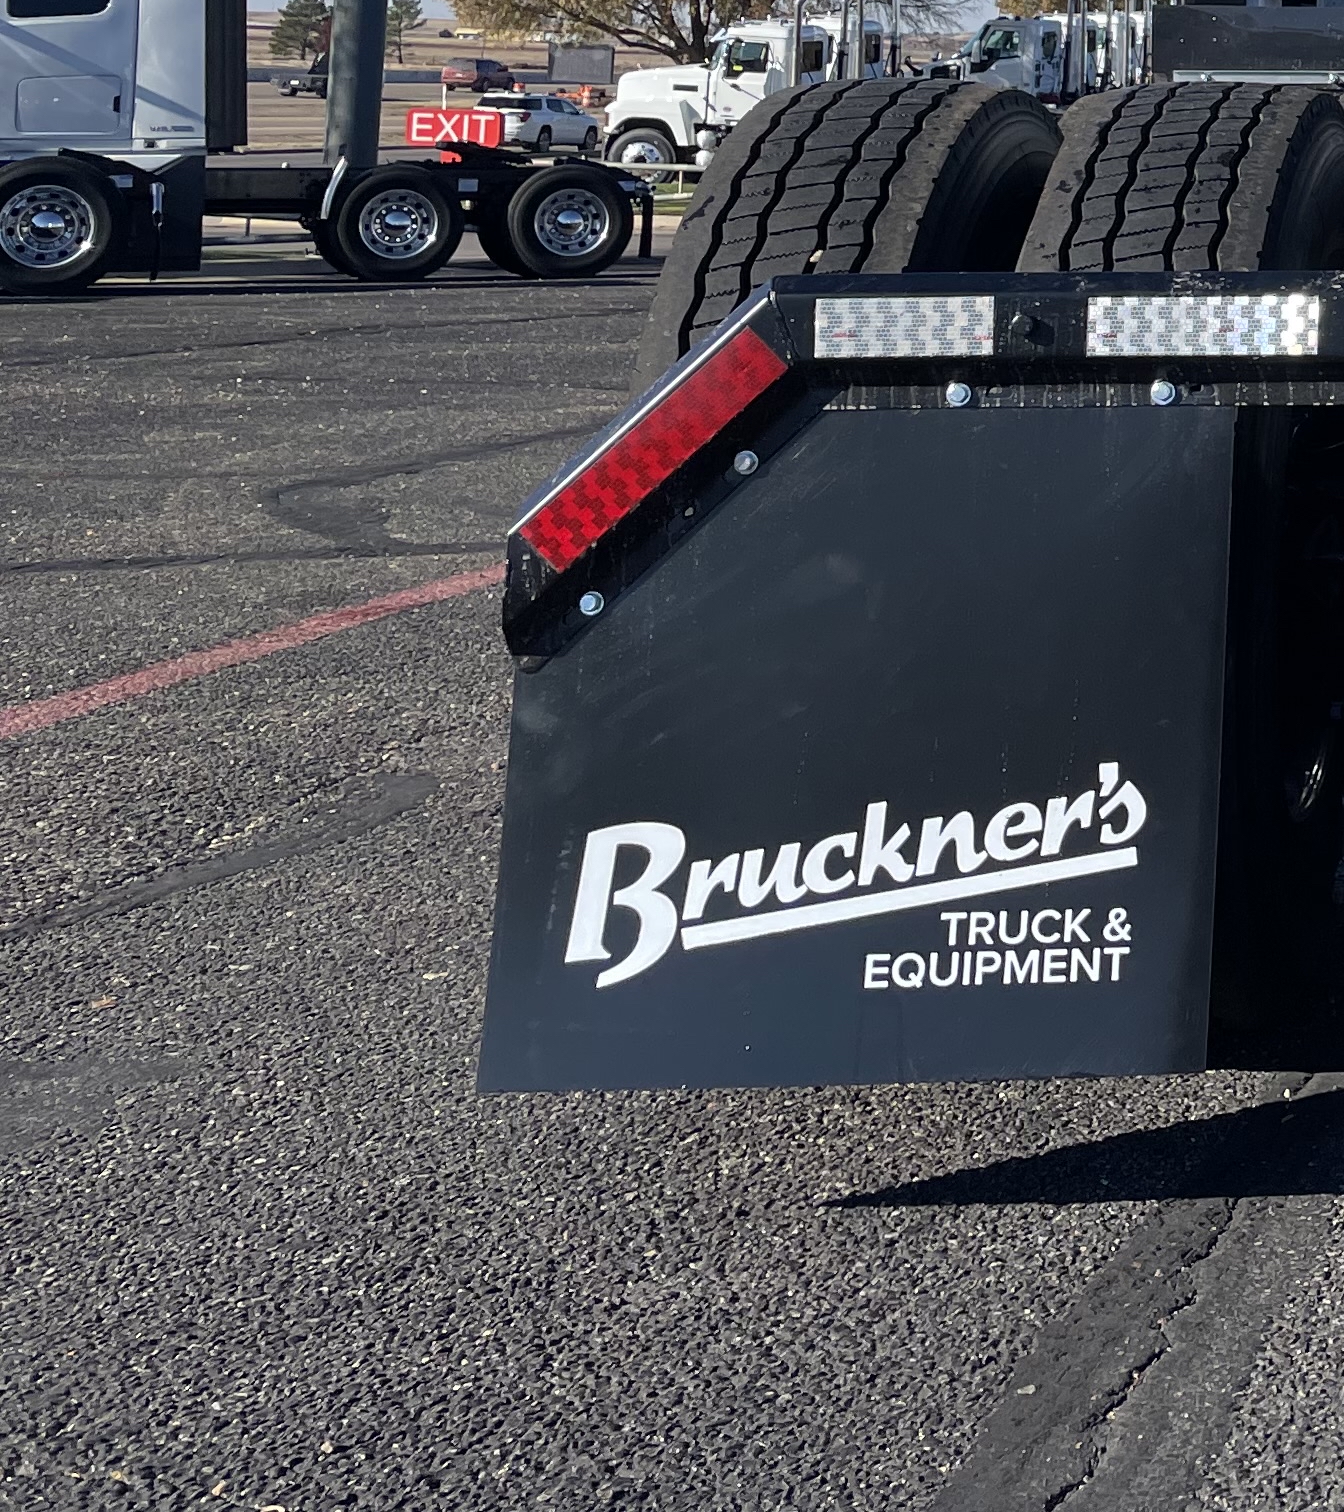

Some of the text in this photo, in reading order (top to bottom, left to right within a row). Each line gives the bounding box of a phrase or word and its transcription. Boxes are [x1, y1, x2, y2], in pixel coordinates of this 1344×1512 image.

[411, 111, 496, 144] EXIT
[564, 761, 1147, 989] Bruckner's
[940, 907, 1132, 947] TRUCK &
[863, 946, 1131, 989] EQUIPMENT
